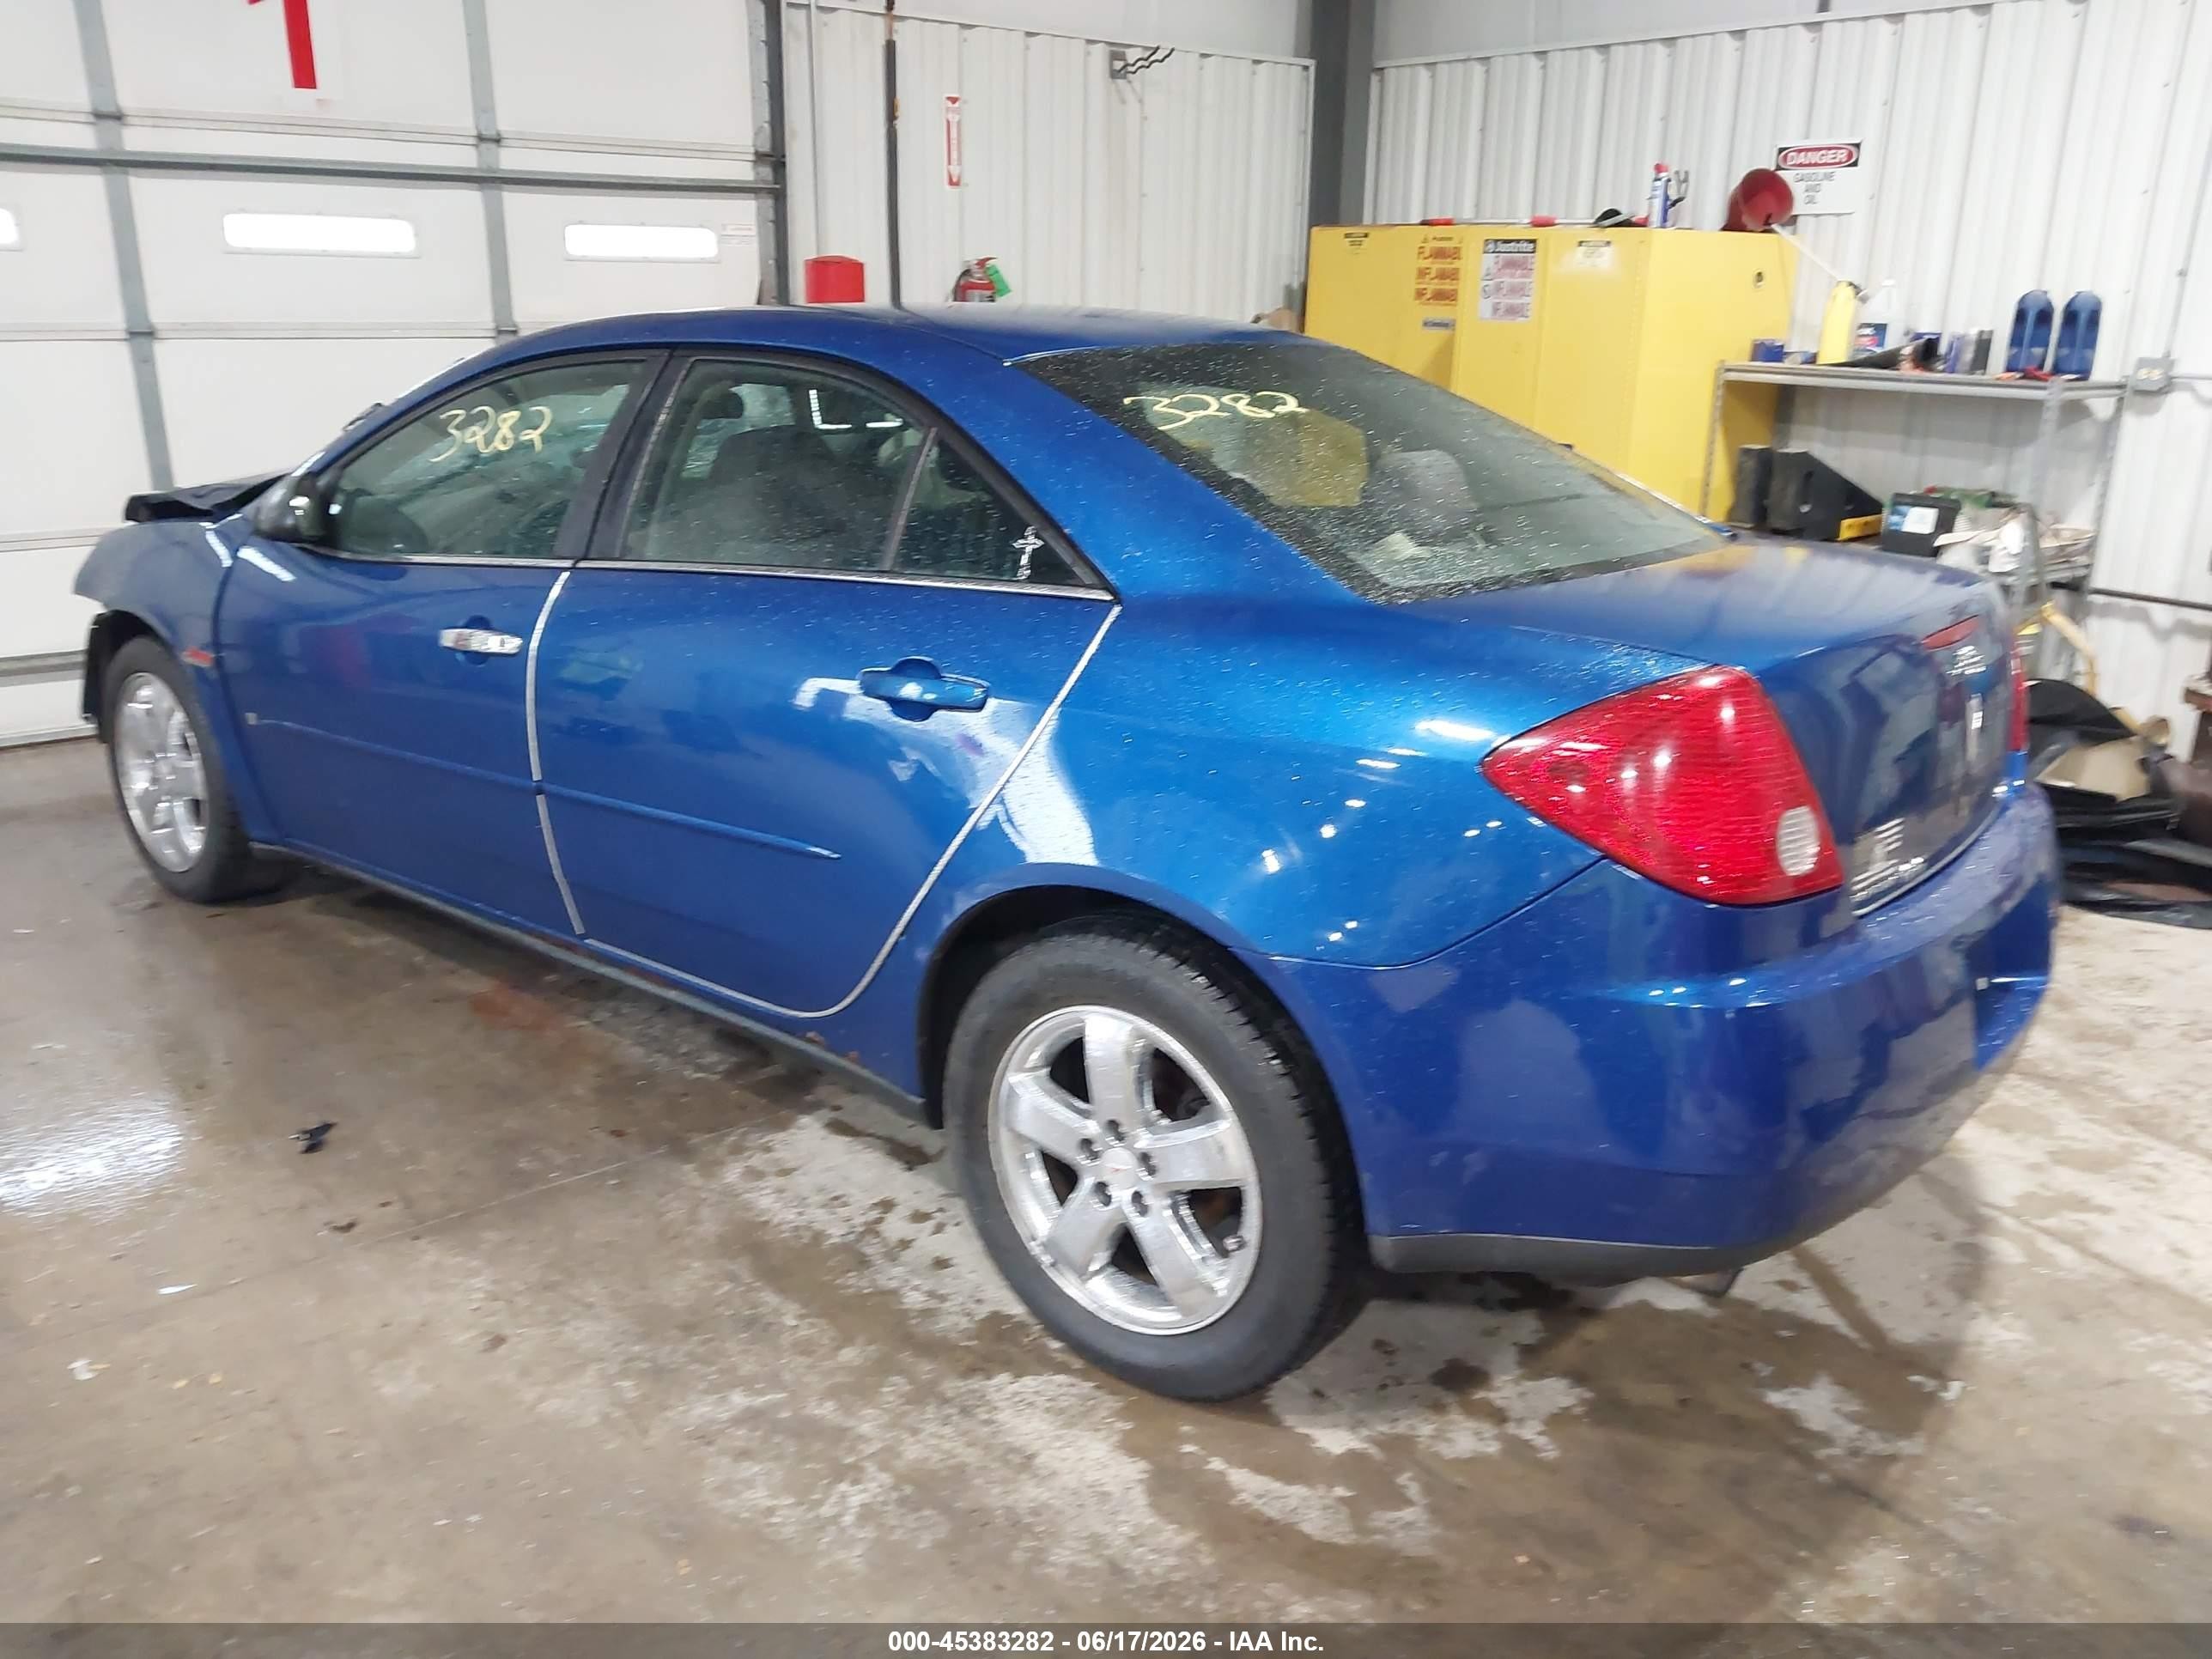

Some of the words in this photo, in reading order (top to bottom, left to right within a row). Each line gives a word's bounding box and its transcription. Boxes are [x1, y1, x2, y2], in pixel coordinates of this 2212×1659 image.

[1786, 149, 1849, 166] DANGER
[1793, 171, 1835, 183] GASOLINE
[1497, 240, 1535, 252] Justrite
[1122, 391, 1302, 430] 3282
[428, 405, 552, 463] 3282
